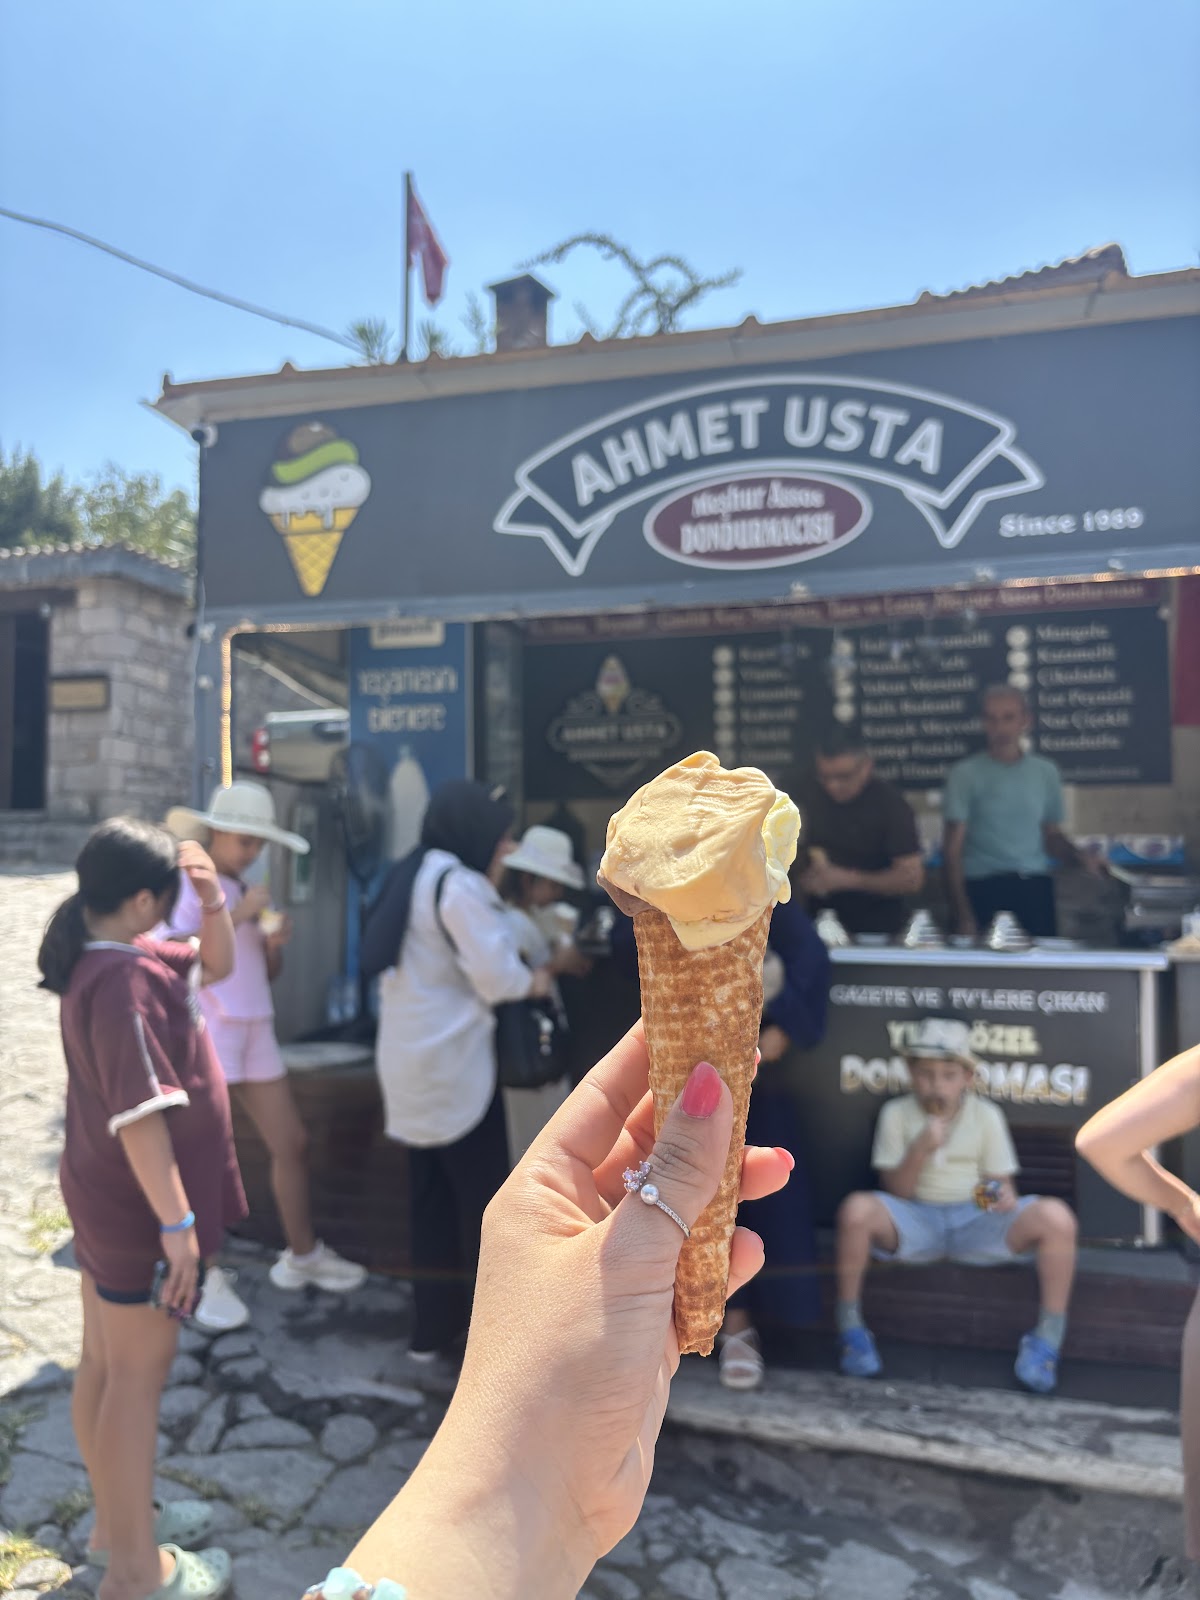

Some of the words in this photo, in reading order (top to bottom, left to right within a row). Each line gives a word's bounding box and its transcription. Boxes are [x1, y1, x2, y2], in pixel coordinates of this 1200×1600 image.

[571, 398, 768, 505] AHMET
[783, 395, 943, 476] USTA
[680, 511, 834, 554] DONDURMACISI
[999, 513, 1077, 538] Since
[829, 984, 910, 1007] GAZETE
[911, 986, 943, 1008] VE
[948, 987, 1037, 1012] TV'LERE
[1037, 989, 1109, 1016] ÇIKAN
[967, 1019, 1041, 1056] ÖZEL
[840, 1054, 1090, 1106] DONRMASI
